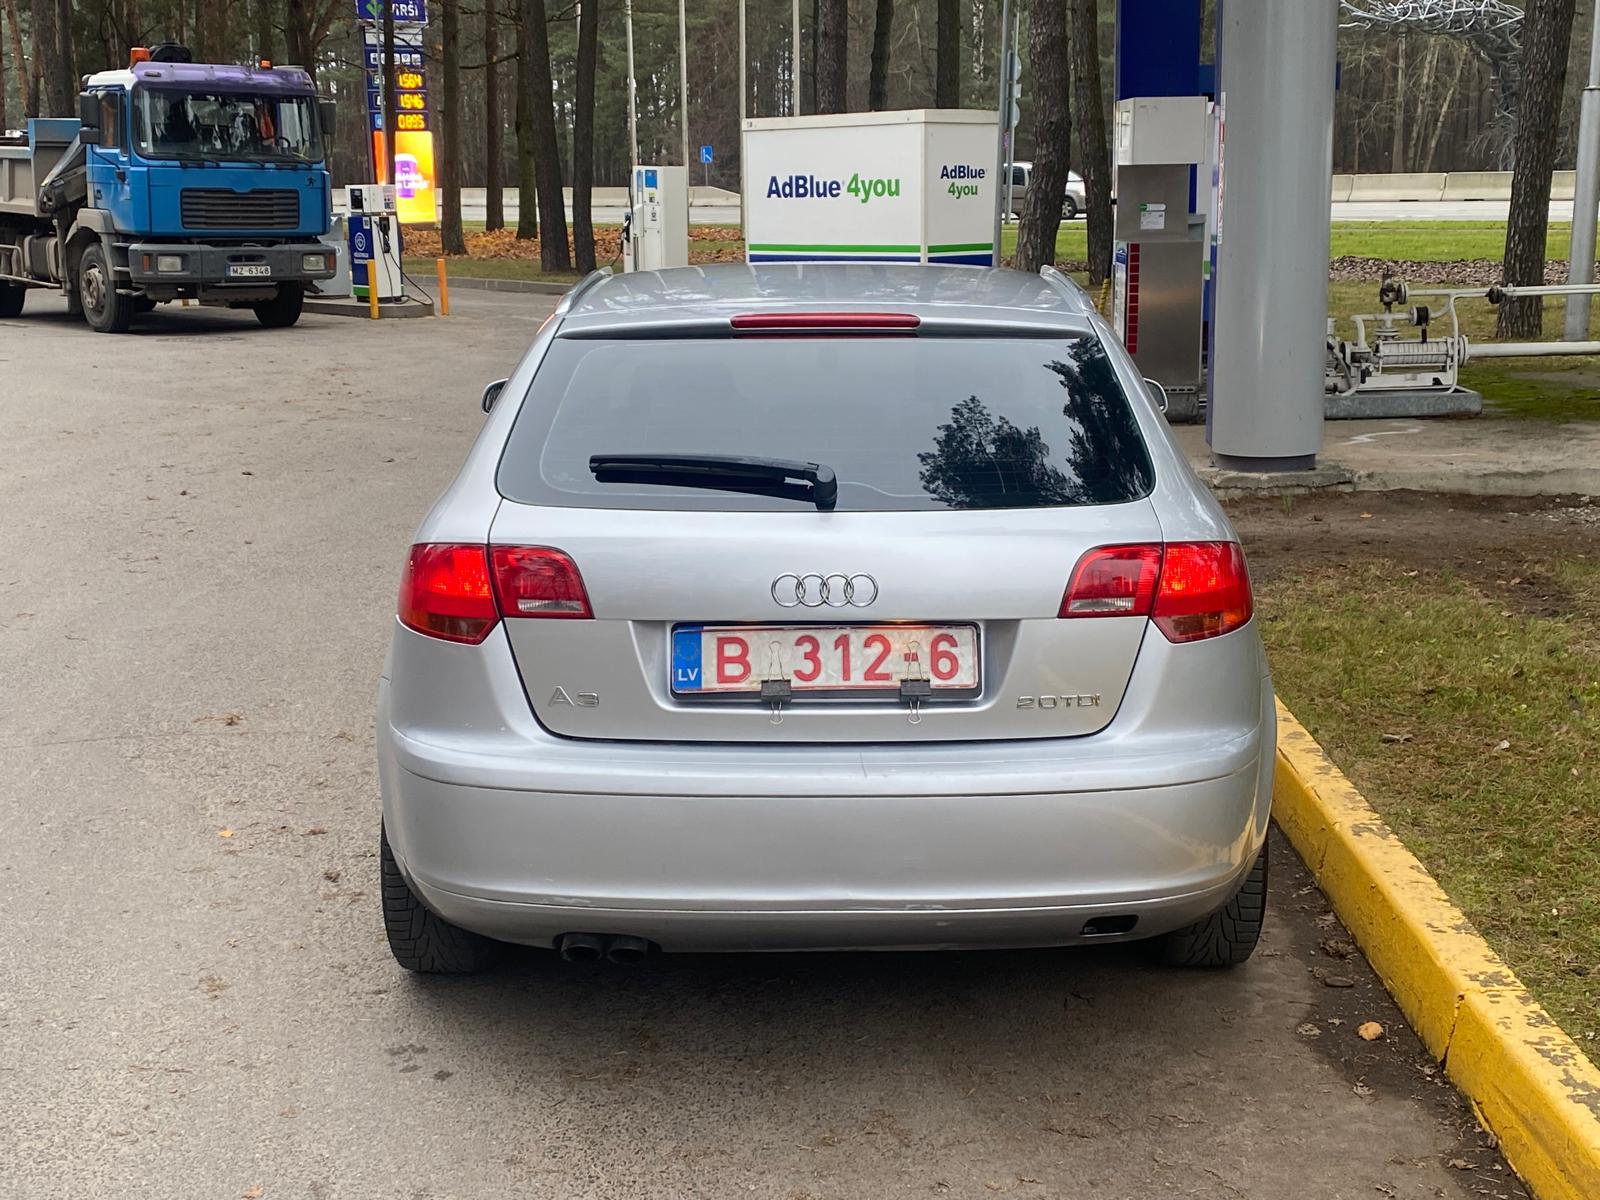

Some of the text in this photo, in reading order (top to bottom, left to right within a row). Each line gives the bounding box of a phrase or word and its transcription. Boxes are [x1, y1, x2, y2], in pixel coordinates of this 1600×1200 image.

[940, 164, 985, 179] AdBlue
[767, 173, 900, 203] AdBlue 4you
[947, 181, 978, 200] 4you
[716, 636, 752, 684] B
[677, 667, 699, 682] LV
[547, 685, 600, 708] A3
